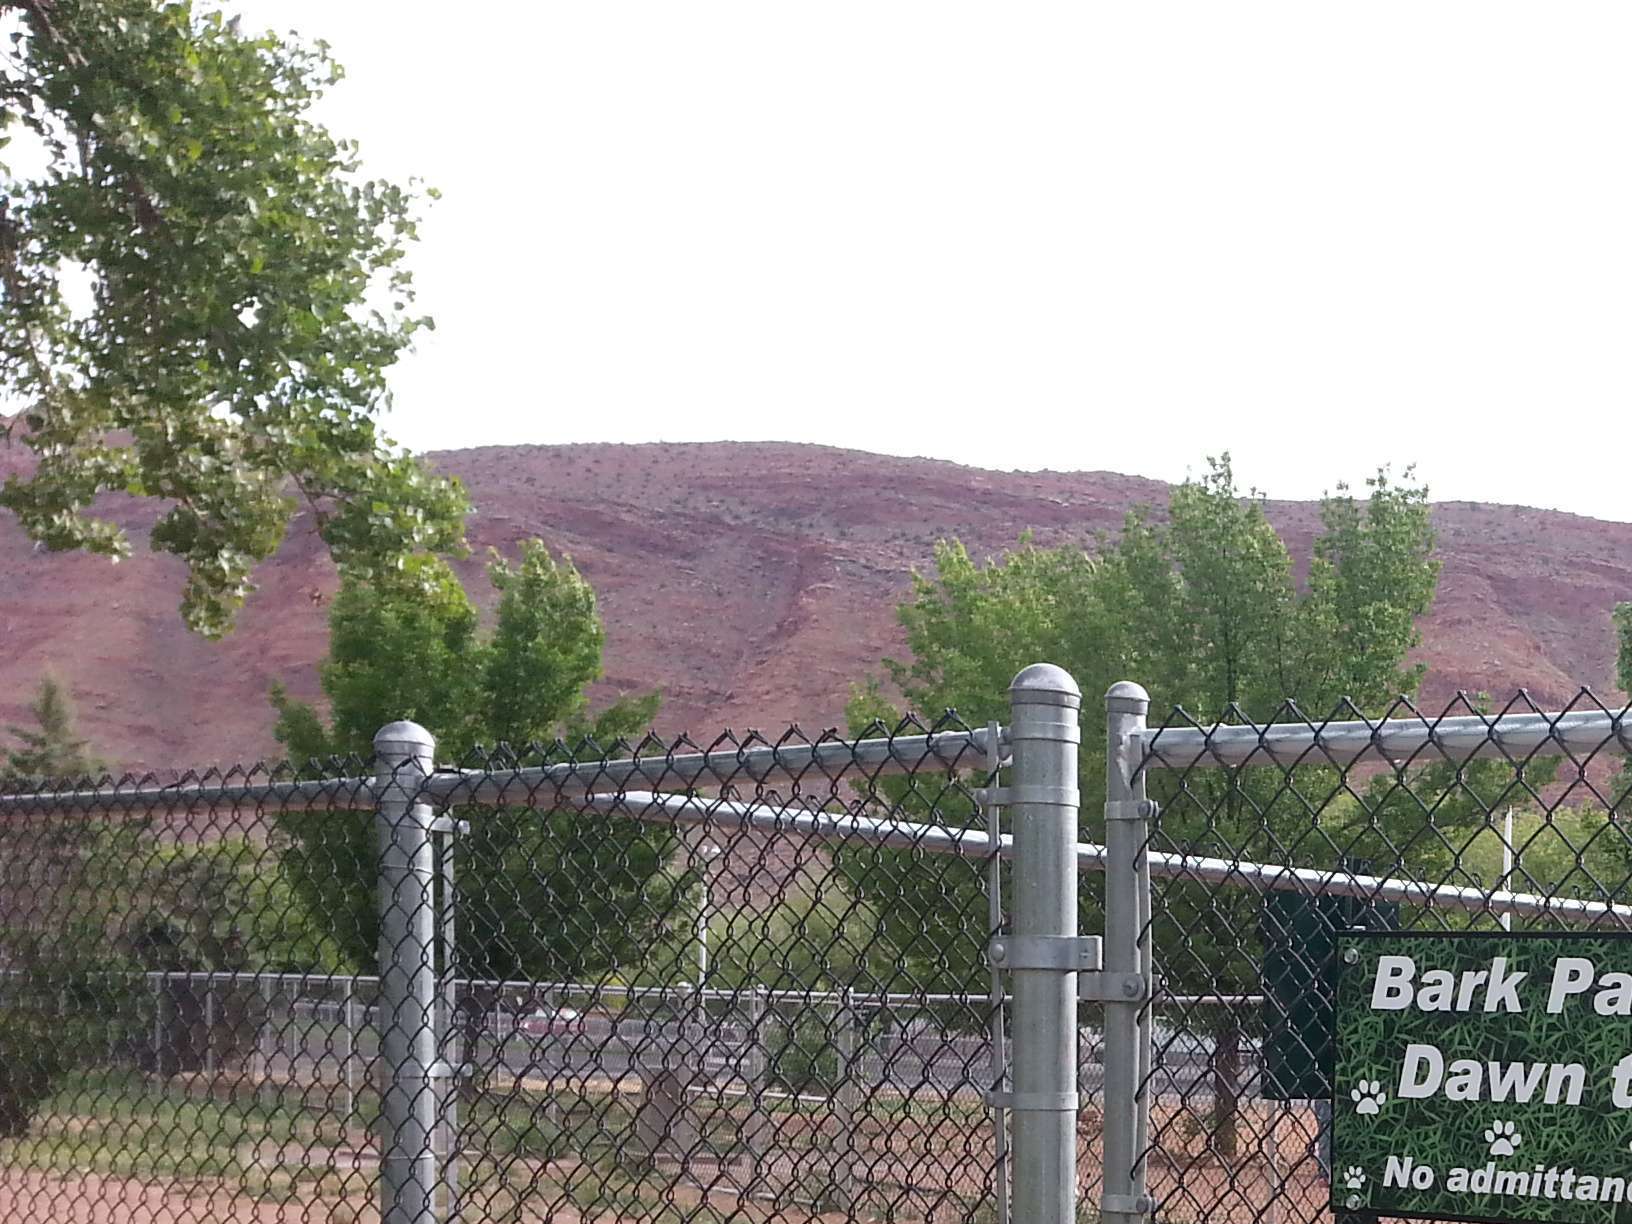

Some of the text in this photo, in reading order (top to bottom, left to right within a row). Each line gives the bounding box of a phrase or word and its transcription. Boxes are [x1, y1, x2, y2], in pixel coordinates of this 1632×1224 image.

[1371, 955, 1527, 1013] Bark
[1397, 1044, 1587, 1106] Dawn
[1383, 1157, 1434, 1191] No
